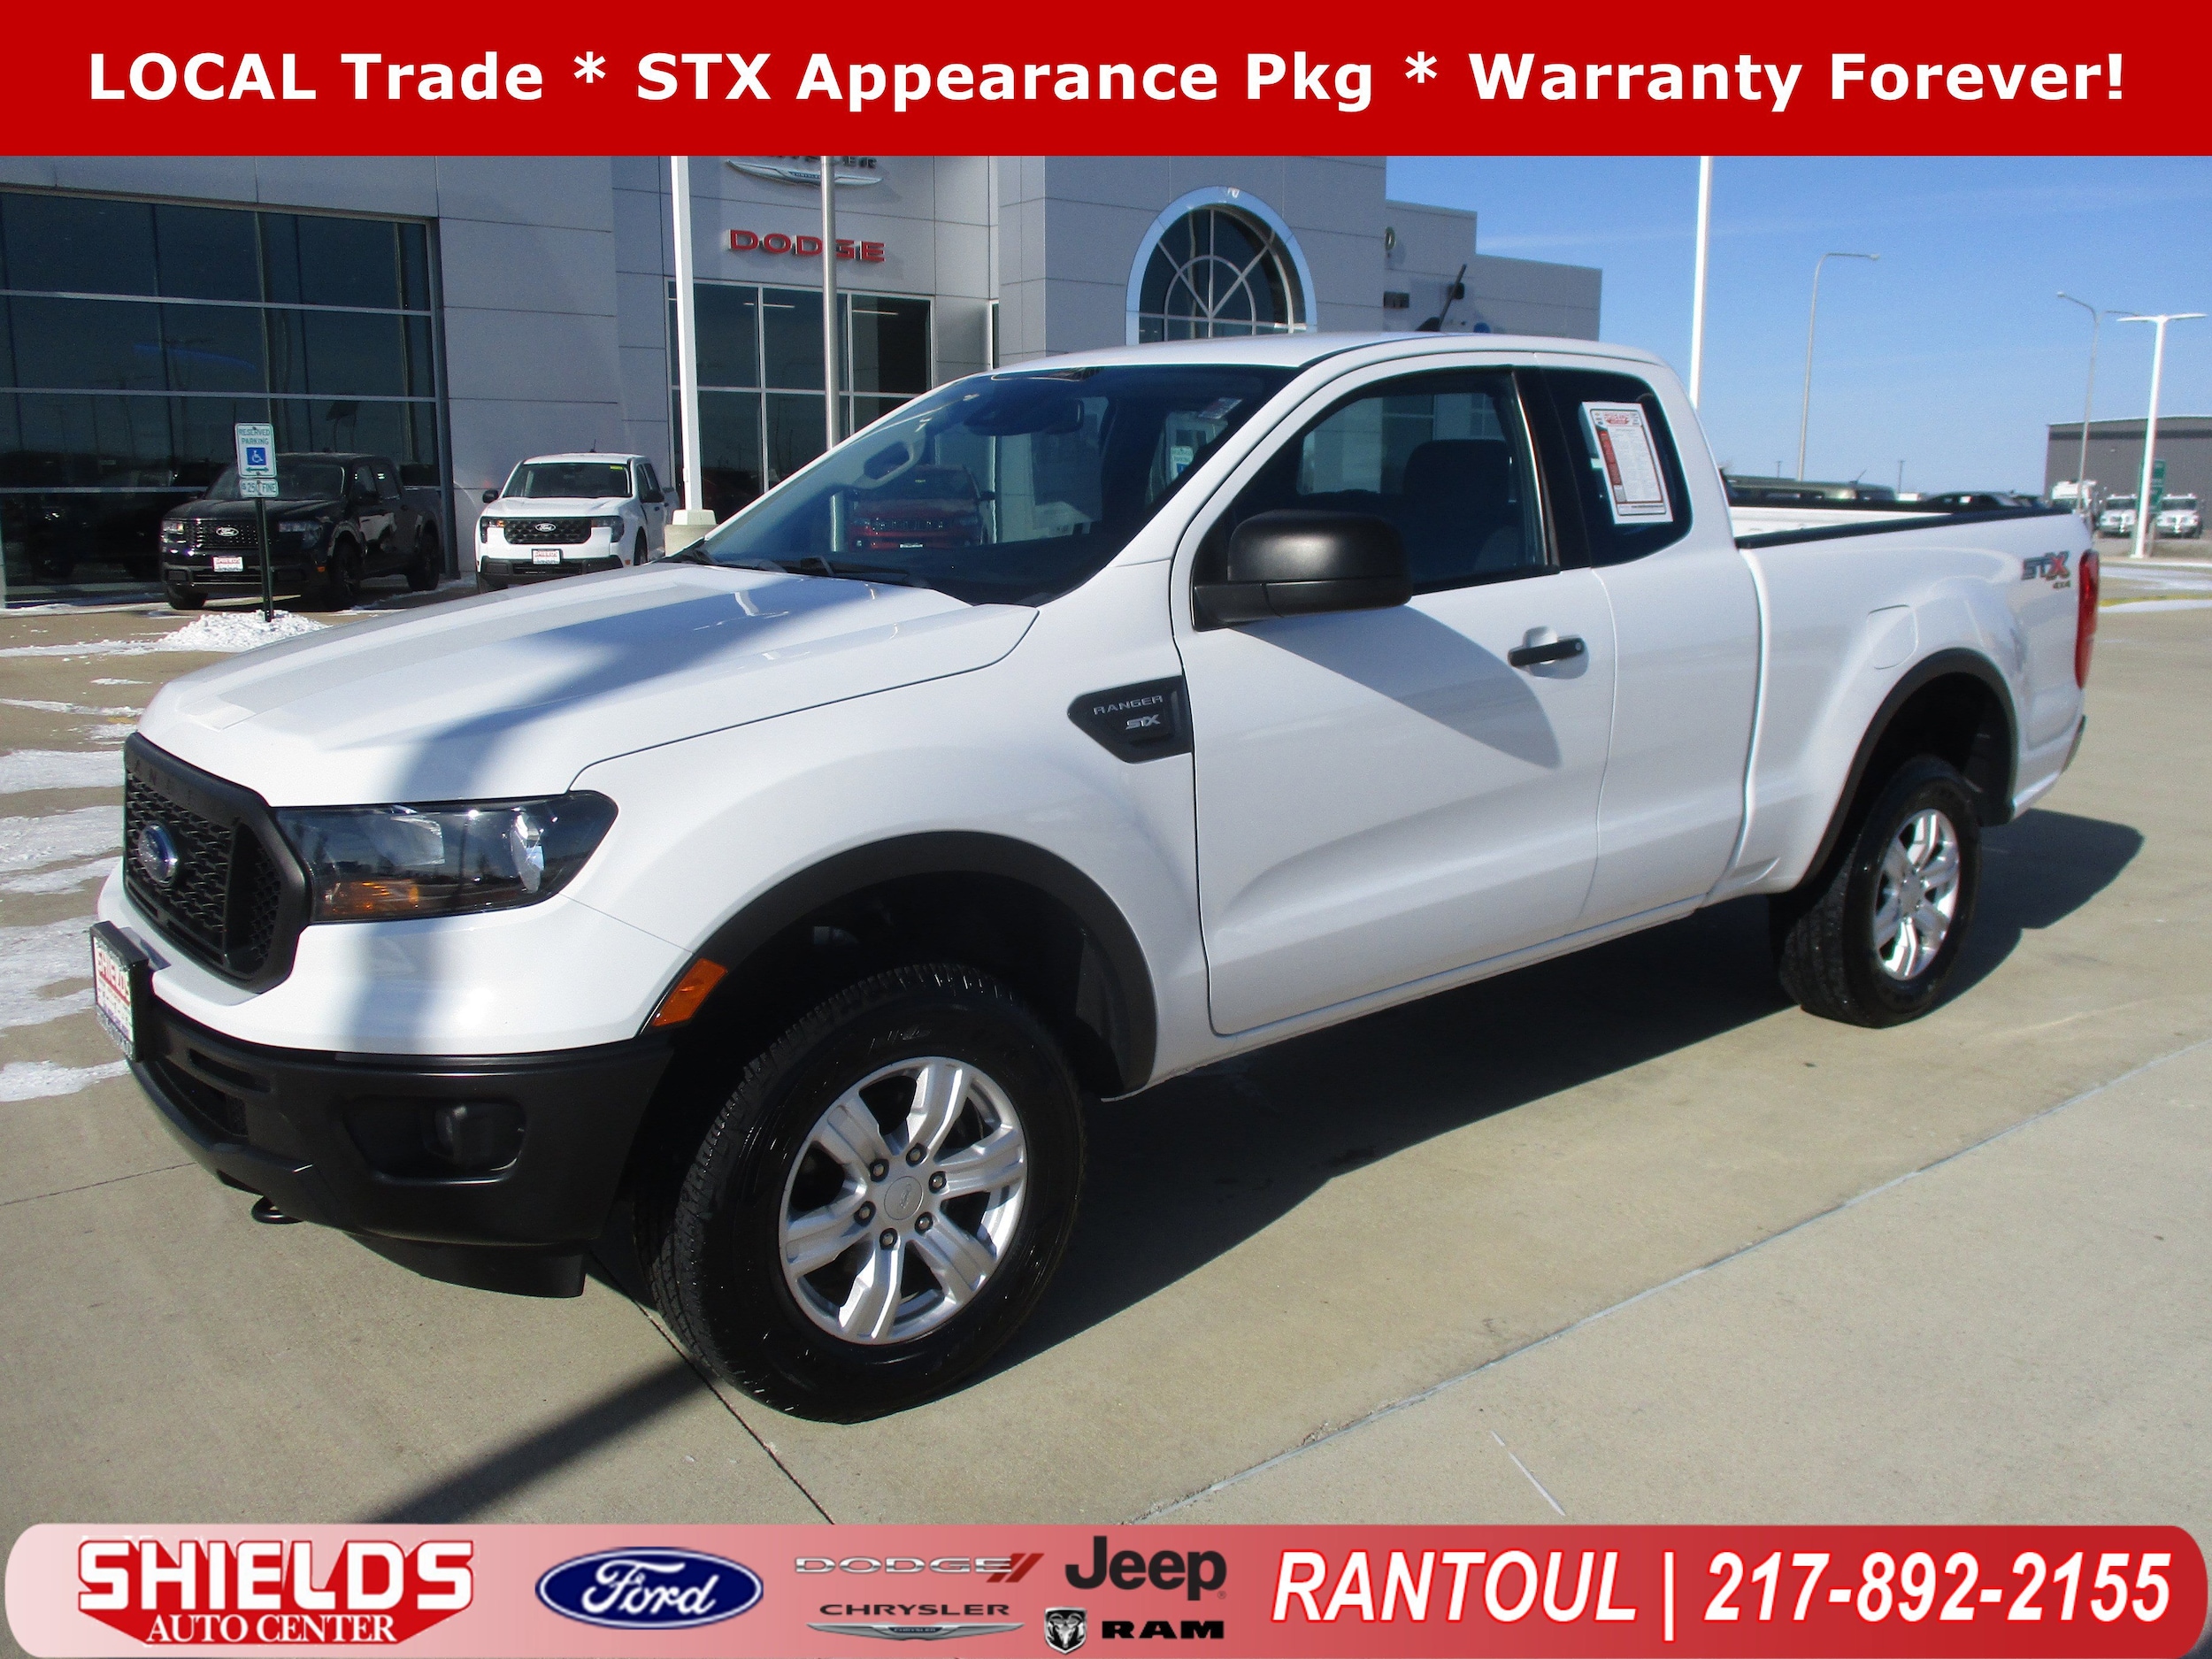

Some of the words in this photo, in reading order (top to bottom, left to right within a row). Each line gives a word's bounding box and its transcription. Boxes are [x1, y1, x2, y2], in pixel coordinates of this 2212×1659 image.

[728, 229, 886, 263] DODGE
[262, 482, 277, 493] FINE
[2021, 551, 2070, 580] STX
[1093, 695, 1164, 715] RANGER
[1125, 714, 1161, 730] STX
